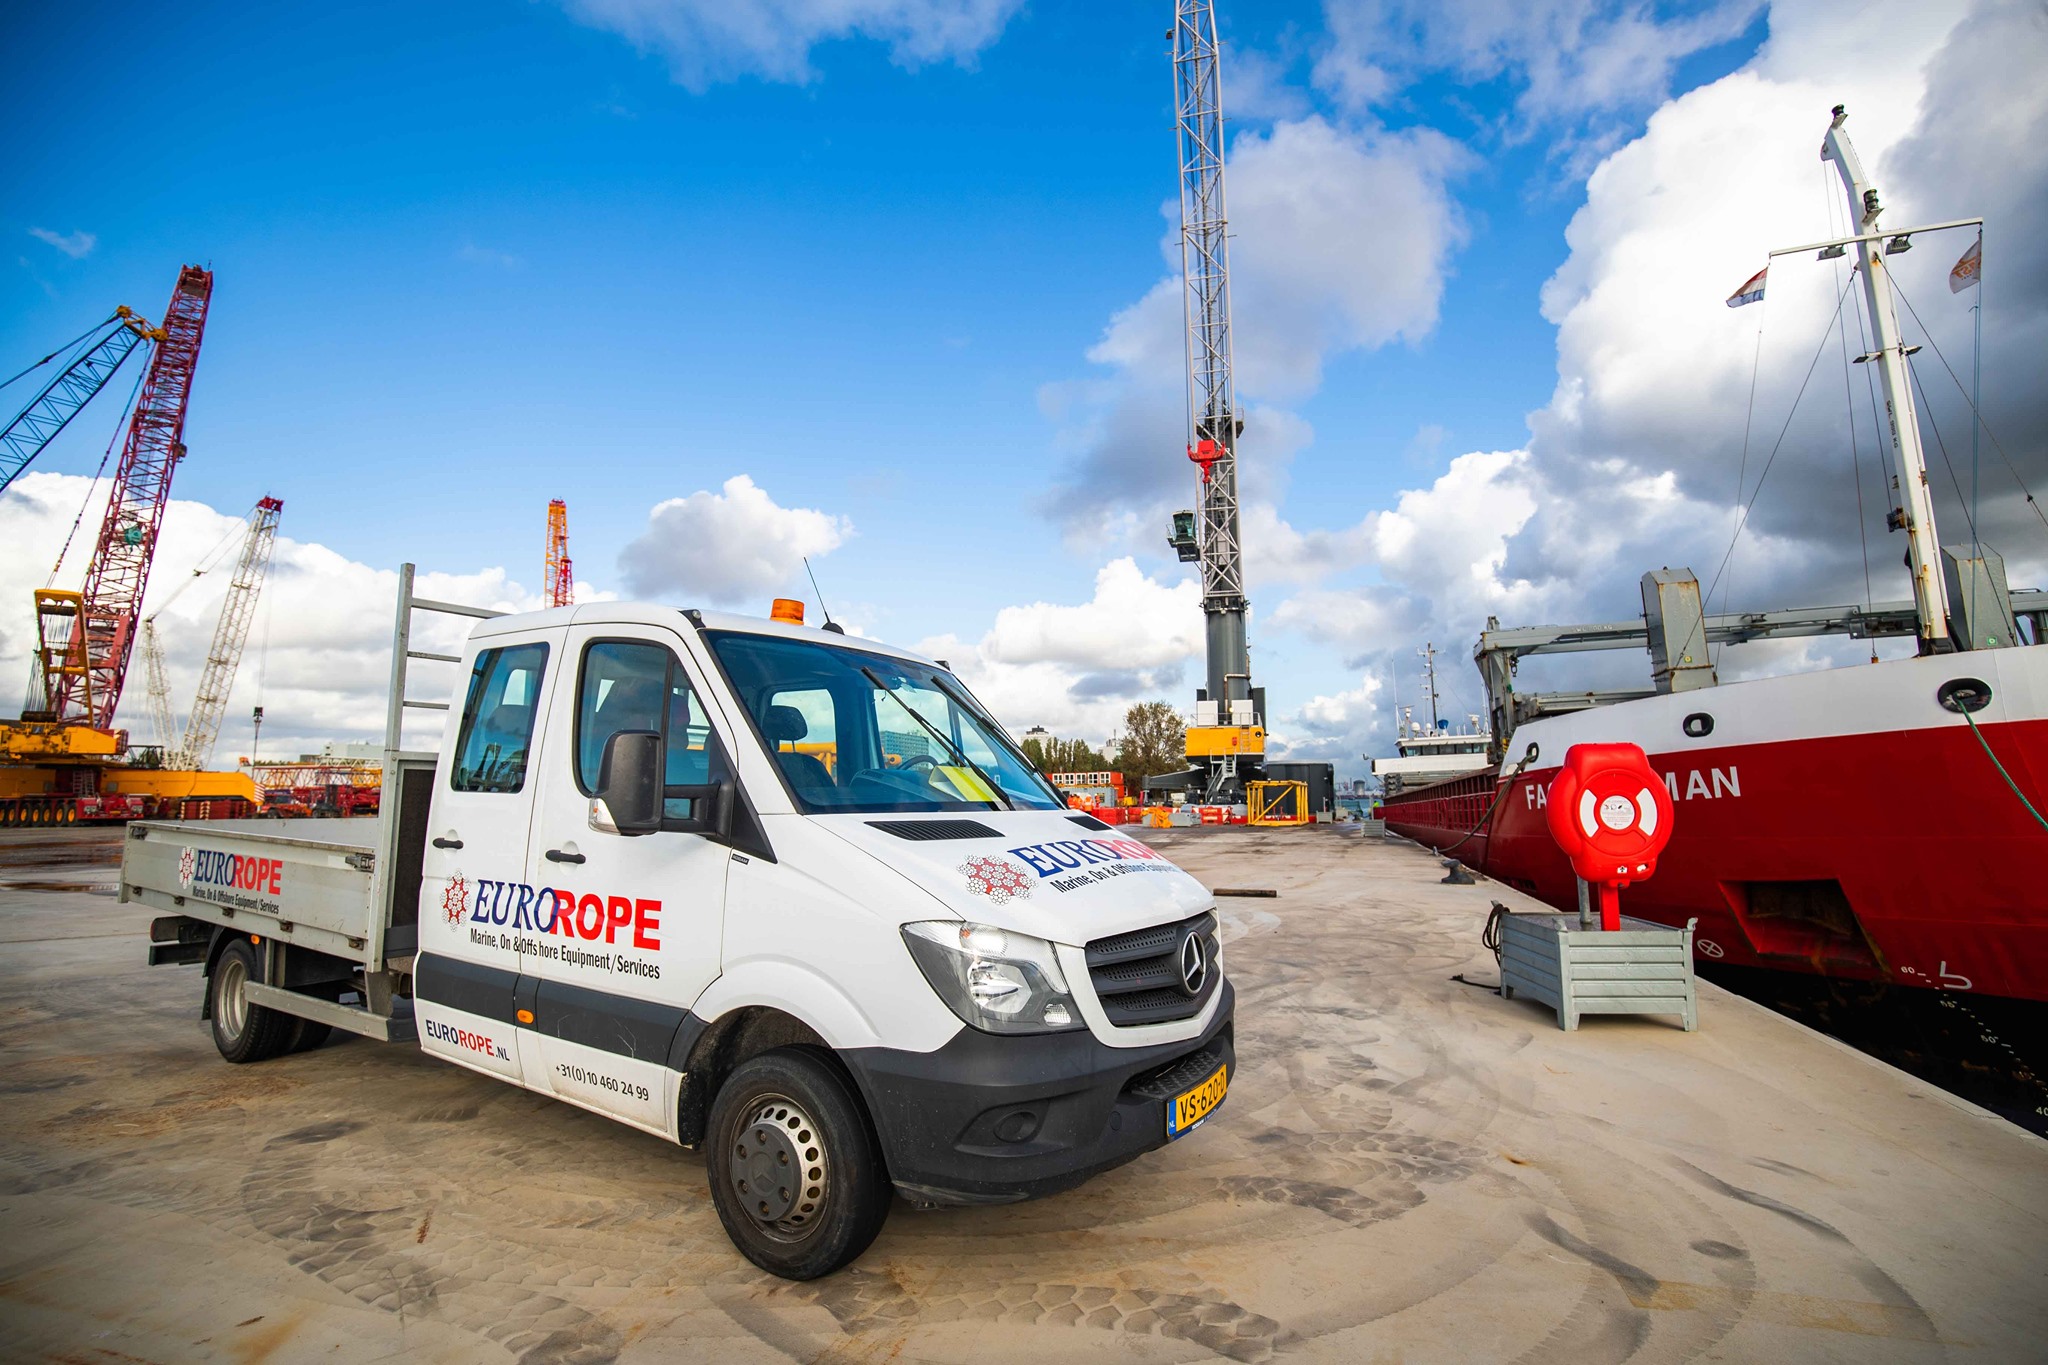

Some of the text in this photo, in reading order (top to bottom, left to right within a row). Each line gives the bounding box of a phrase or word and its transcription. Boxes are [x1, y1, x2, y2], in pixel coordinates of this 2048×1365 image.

[1665, 765, 1742, 802] MAN
[193, 849, 283, 896] EUROROPE
[1049, 875, 1099, 893] Marine,
[1088, 870, 1110, 881] On
[470, 878, 662, 952] EUROROPE
[470, 927, 498, 951] Marine,
[500, 933, 511, 951] On
[513, 935, 520, 952] &
[425, 1019, 510, 1062] EUROROPE.NL
[600, 1075, 619, 1092] 460
[621, 1081, 634, 1097] 24
[636, 1085, 649, 1101] 99
[1180, 1071, 1225, 1123] VS-620-D
